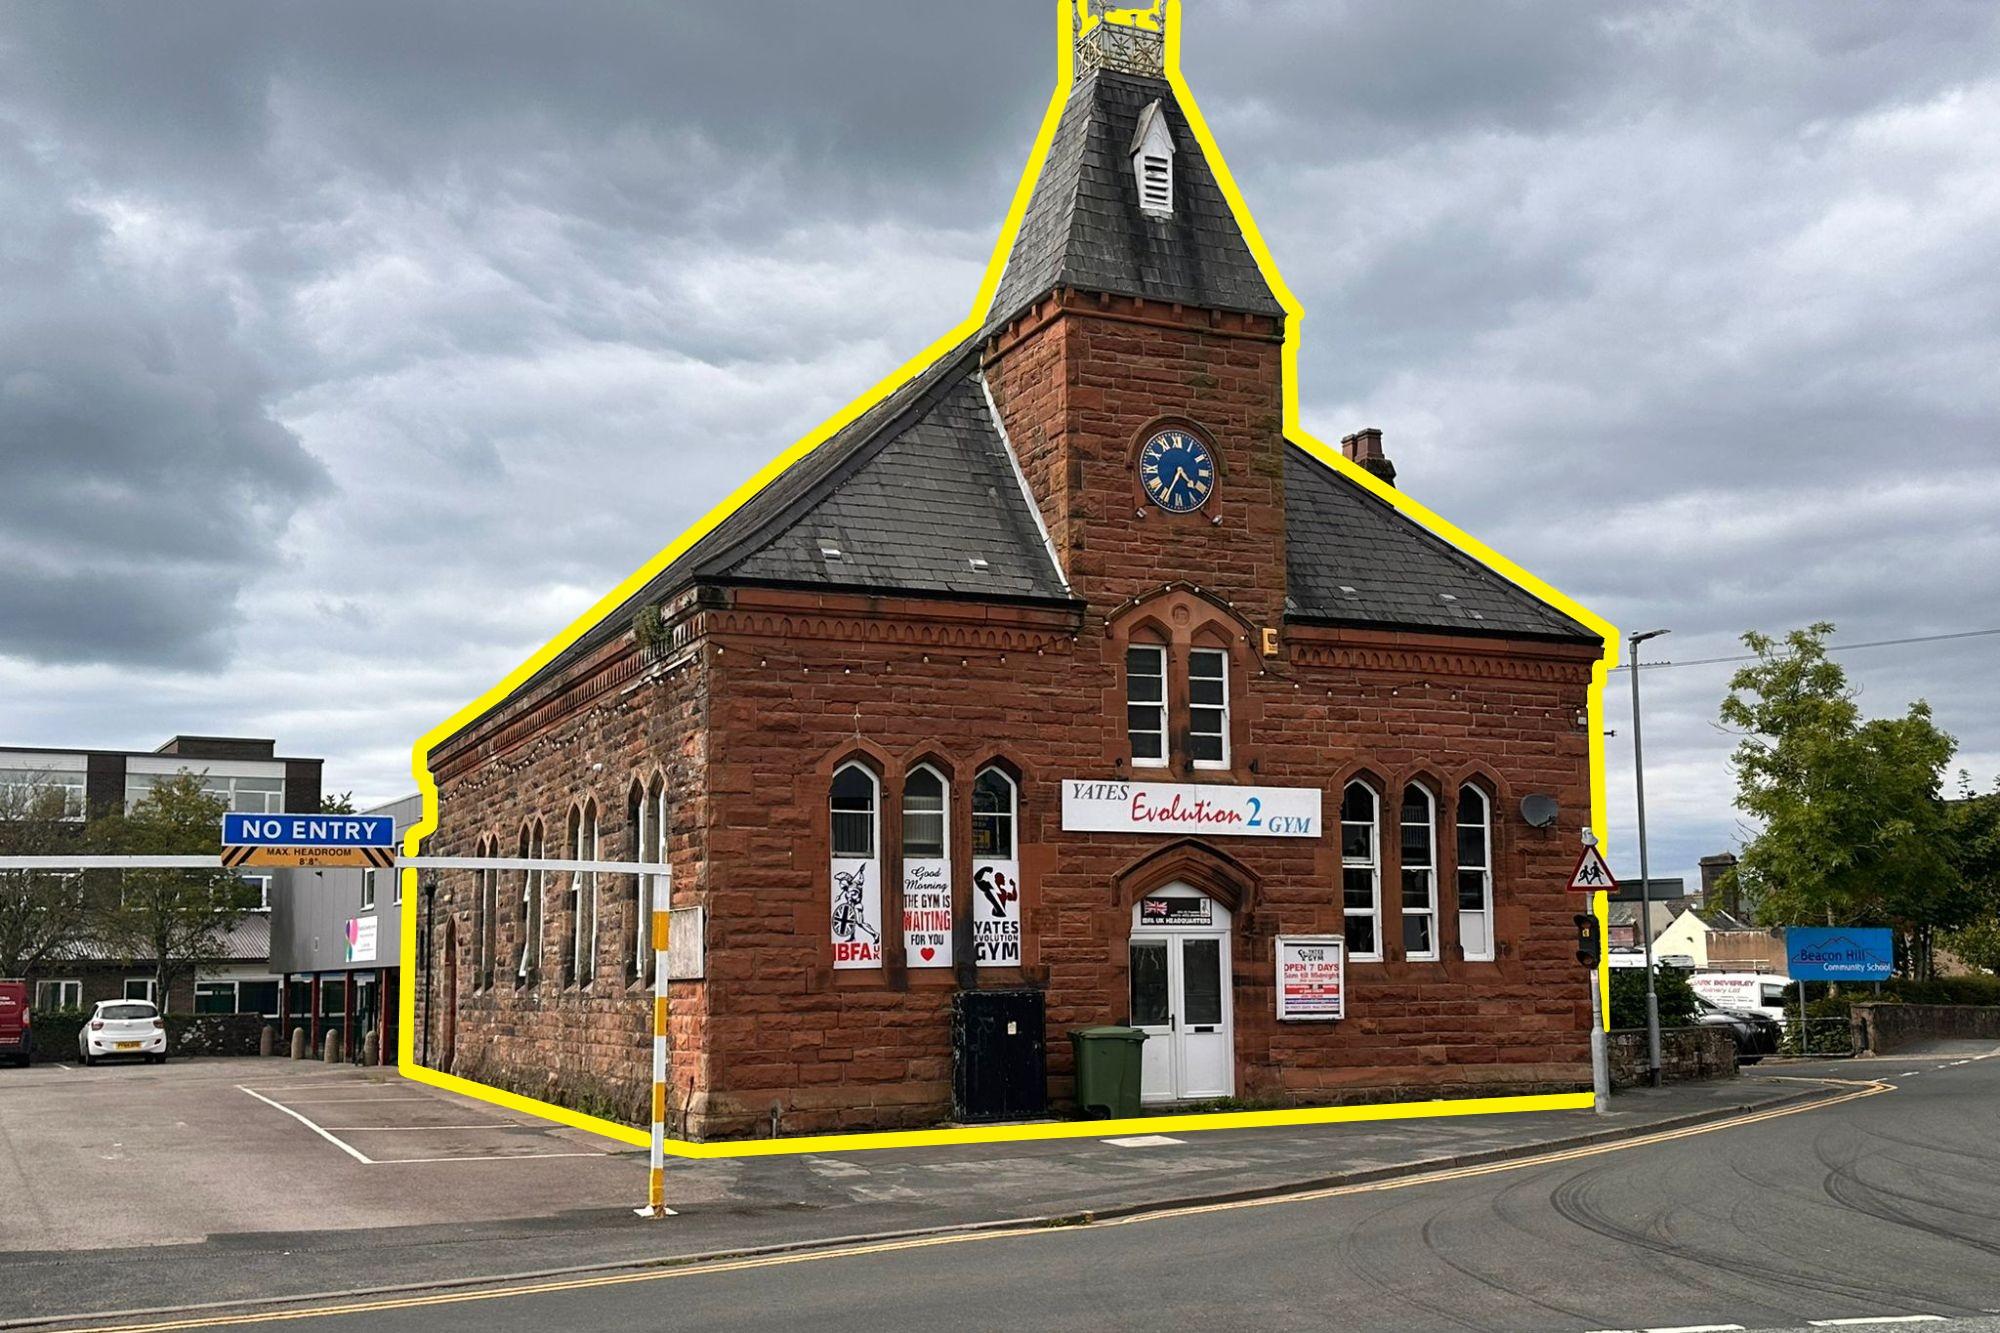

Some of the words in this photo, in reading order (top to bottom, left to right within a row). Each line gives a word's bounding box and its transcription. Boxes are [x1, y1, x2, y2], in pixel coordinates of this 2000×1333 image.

[1073, 783, 1129, 801] YATES
[1131, 792, 1242, 824] Evolution
[1246, 797, 1262, 827] 2
[1269, 816, 1311, 834] GYM
[242, 820, 282, 839] NO
[292, 821, 377, 840] ENTRY
[267, 848, 290, 856] MAX.
[294, 848, 352, 856] HEADROOM
[911, 866, 942, 881] Good
[905, 879, 949, 893] Morning
[904, 894, 918, 908] THE
[921, 894, 940, 908] GYM
[943, 895, 951, 908] IS
[904, 911, 951, 932] WAITING
[974, 921, 1019, 934] YATES
[911, 934, 926, 945] FOR
[928, 934, 944, 945] YOU
[974, 934, 1019, 942] EVOLUTION
[975, 942, 1019, 961] GYM
[1800, 949, 1842, 961] Beacon
[1846, 949, 1866, 961] Hill
[1823, 962, 1866, 972] Community
[1867, 962, 1891, 972] School
